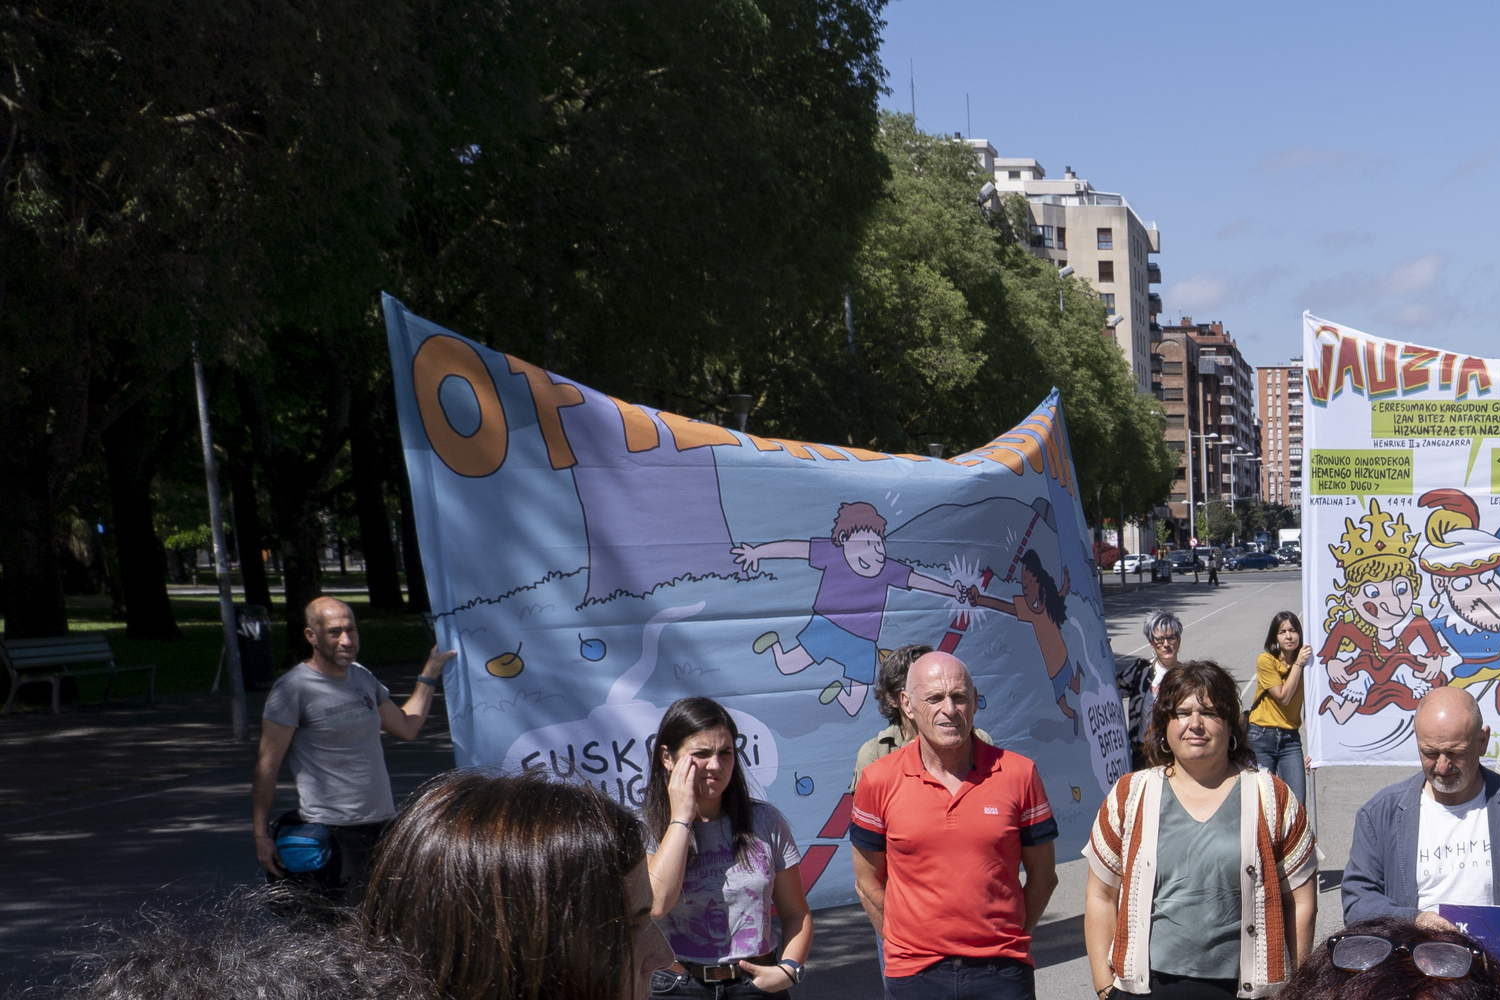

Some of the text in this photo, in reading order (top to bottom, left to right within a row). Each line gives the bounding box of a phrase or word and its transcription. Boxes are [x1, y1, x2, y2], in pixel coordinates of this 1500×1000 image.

[1307, 325, 1492, 408] JAUZIA
[1439, 403, 1488, 413] KARGUDUN
[1393, 414, 1414, 424] IZAN
[1418, 414, 1445, 423] BITEZ
[1393, 425, 1456, 436] HIZKUNTZAZ
[1459, 425, 1477, 436] ETA
[1373, 439, 1406, 448] HENRIKE
[1422, 439, 1471, 448] ZANGOZARRA
[1354, 456, 1410, 466] OINORDEKOA
[1311, 467, 1410, 479] HEMENGO HIZKUNTZAN
[1318, 480, 1346, 490] HEZIKO
[1309, 497, 1343, 506] KATALINA
